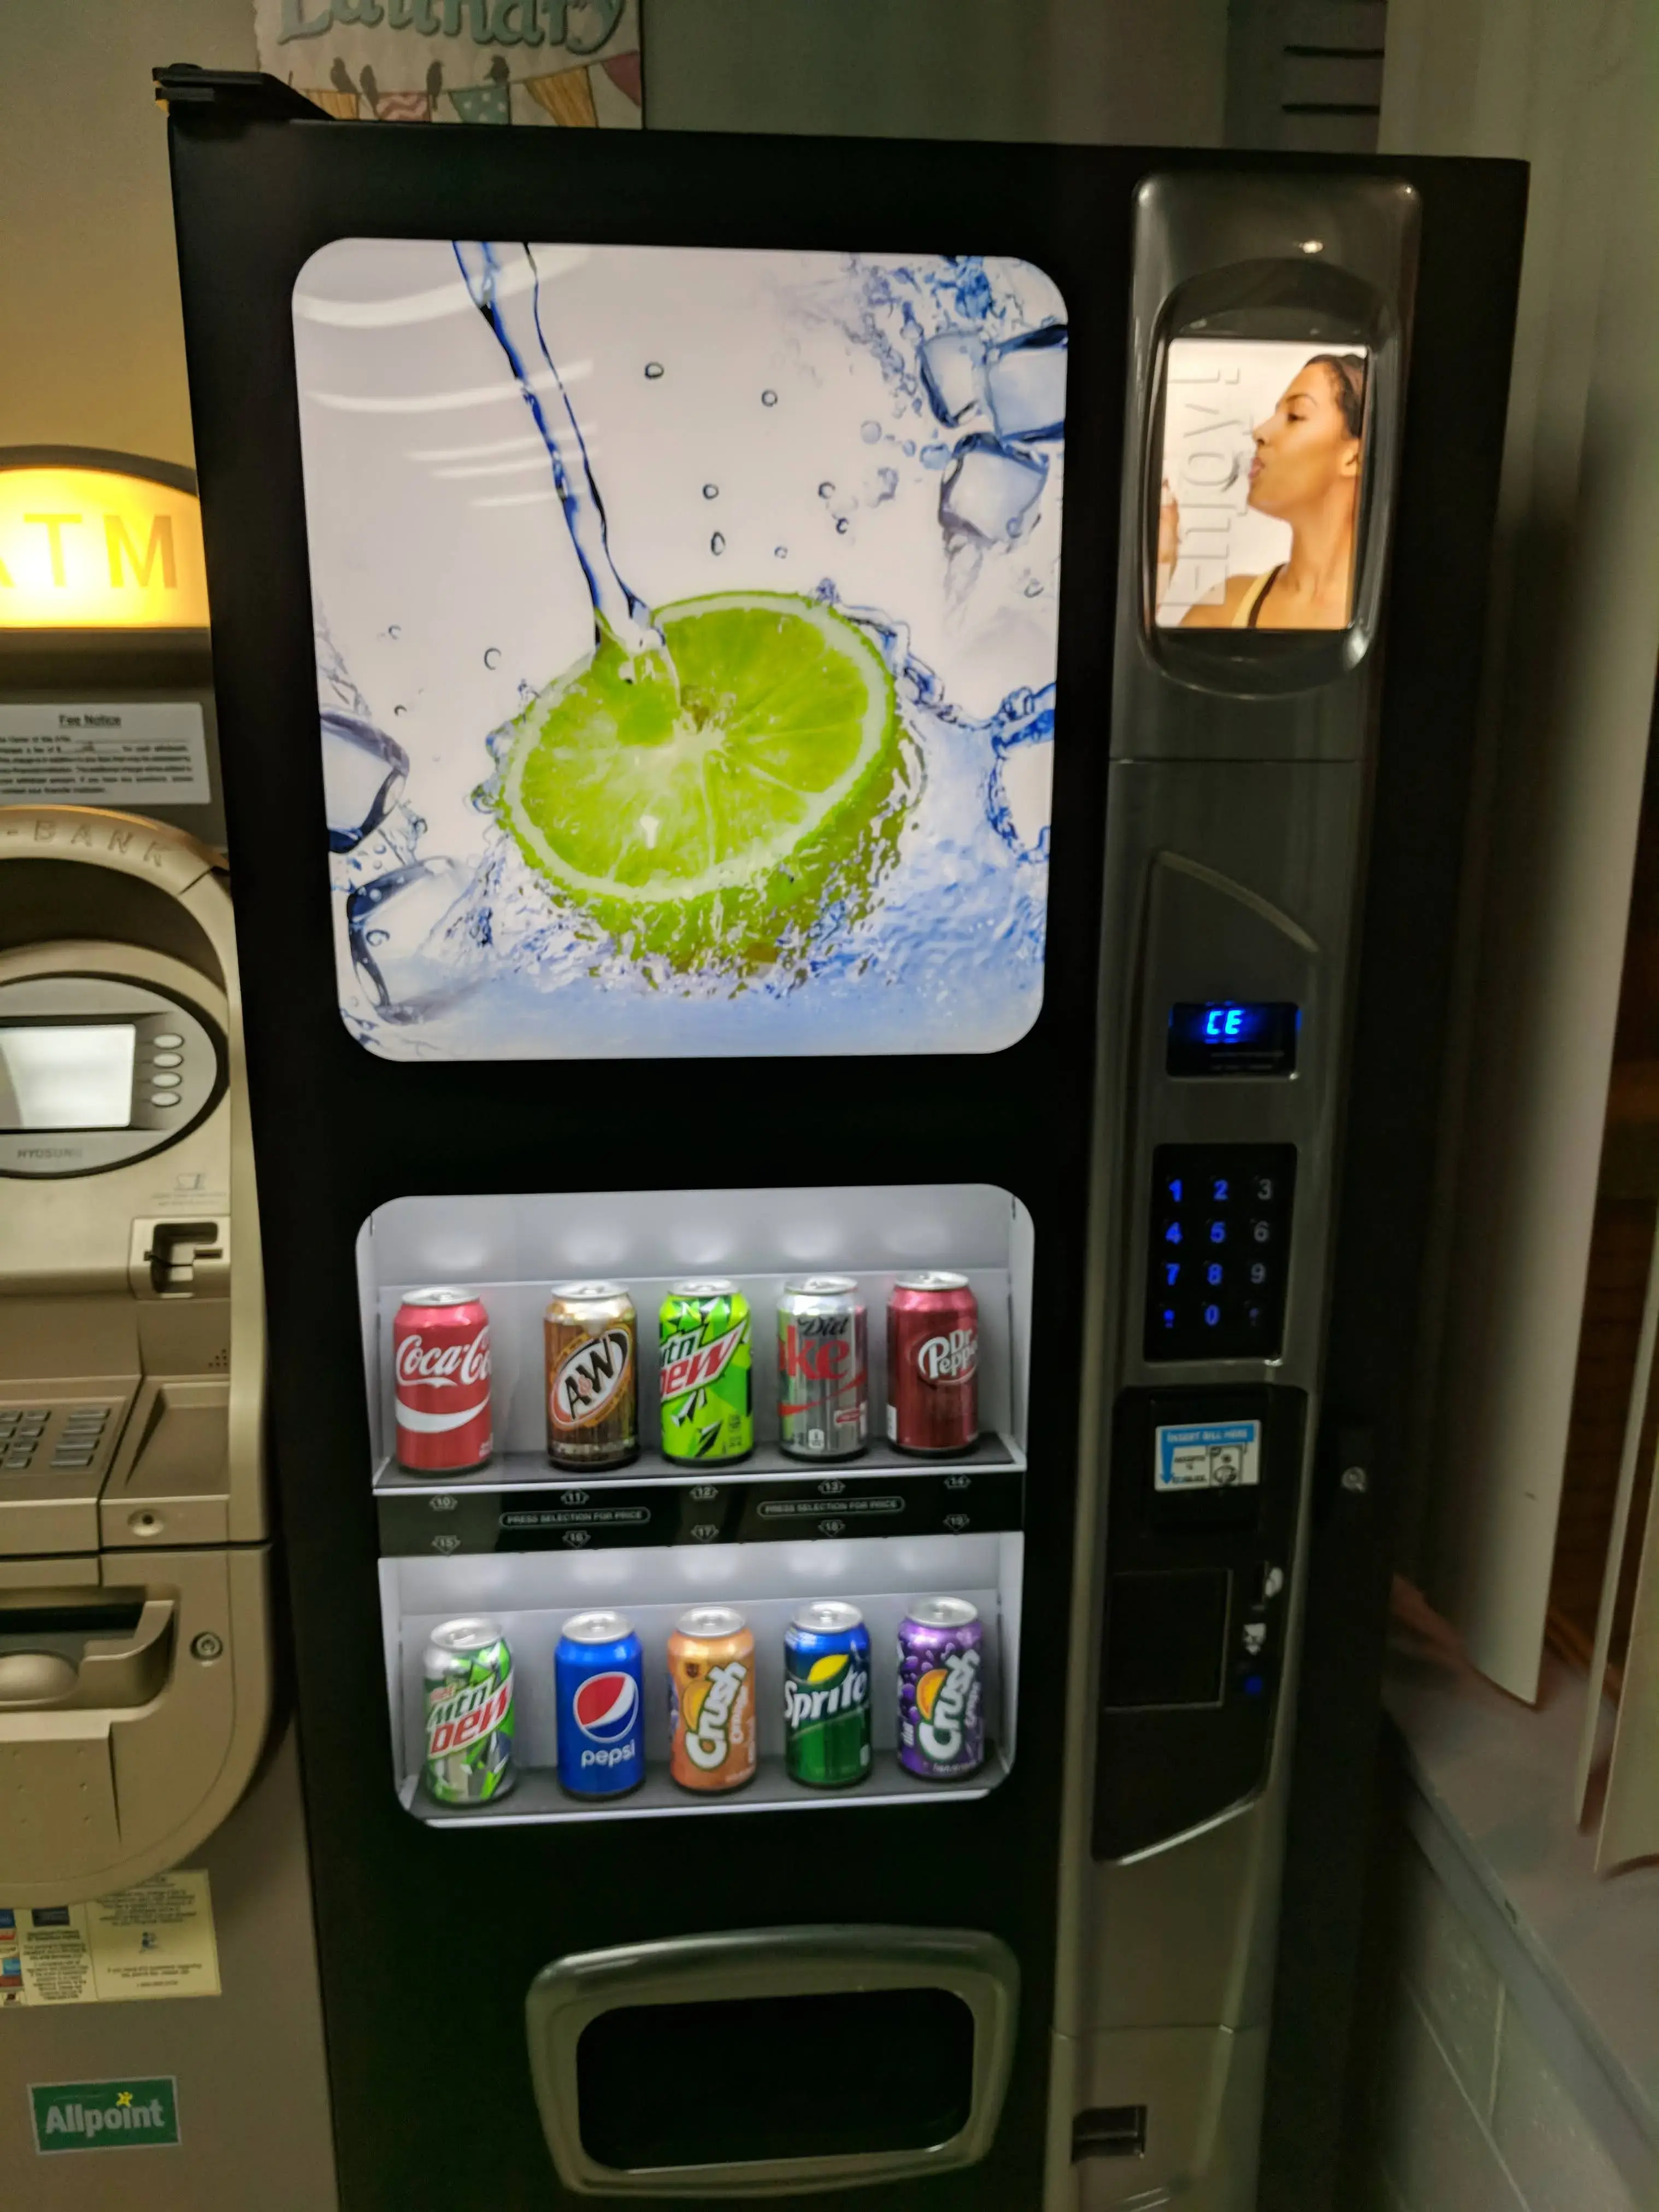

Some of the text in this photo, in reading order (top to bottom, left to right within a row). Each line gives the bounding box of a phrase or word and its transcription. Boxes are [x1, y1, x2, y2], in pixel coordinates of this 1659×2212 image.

[0, 513, 177, 589] TM
[1169, 1179, 1272, 1202] 1 2 3
[1165, 1222, 1183, 1245] 4
[1254, 1220, 1269, 1242] 6
[1166, 1263, 1266, 1285] 7 8 9
[949, 1328, 973, 1354] Dr
[564, 1338, 615, 1420] A&W
[437, 1497, 450, 1507] 10
[568, 1492, 581, 1502] 11
[698, 1487, 711, 1497] 12
[507, 1510, 643, 1523] PRESS SELECTION FOR PRICE
[439, 1538, 453, 1548] 15
[699, 1527, 711, 1537] 17
[785, 1664, 868, 1728] Sprite
[581, 1739, 636, 1769] pepsi
[46, 2098, 166, 2138] Allpoint
